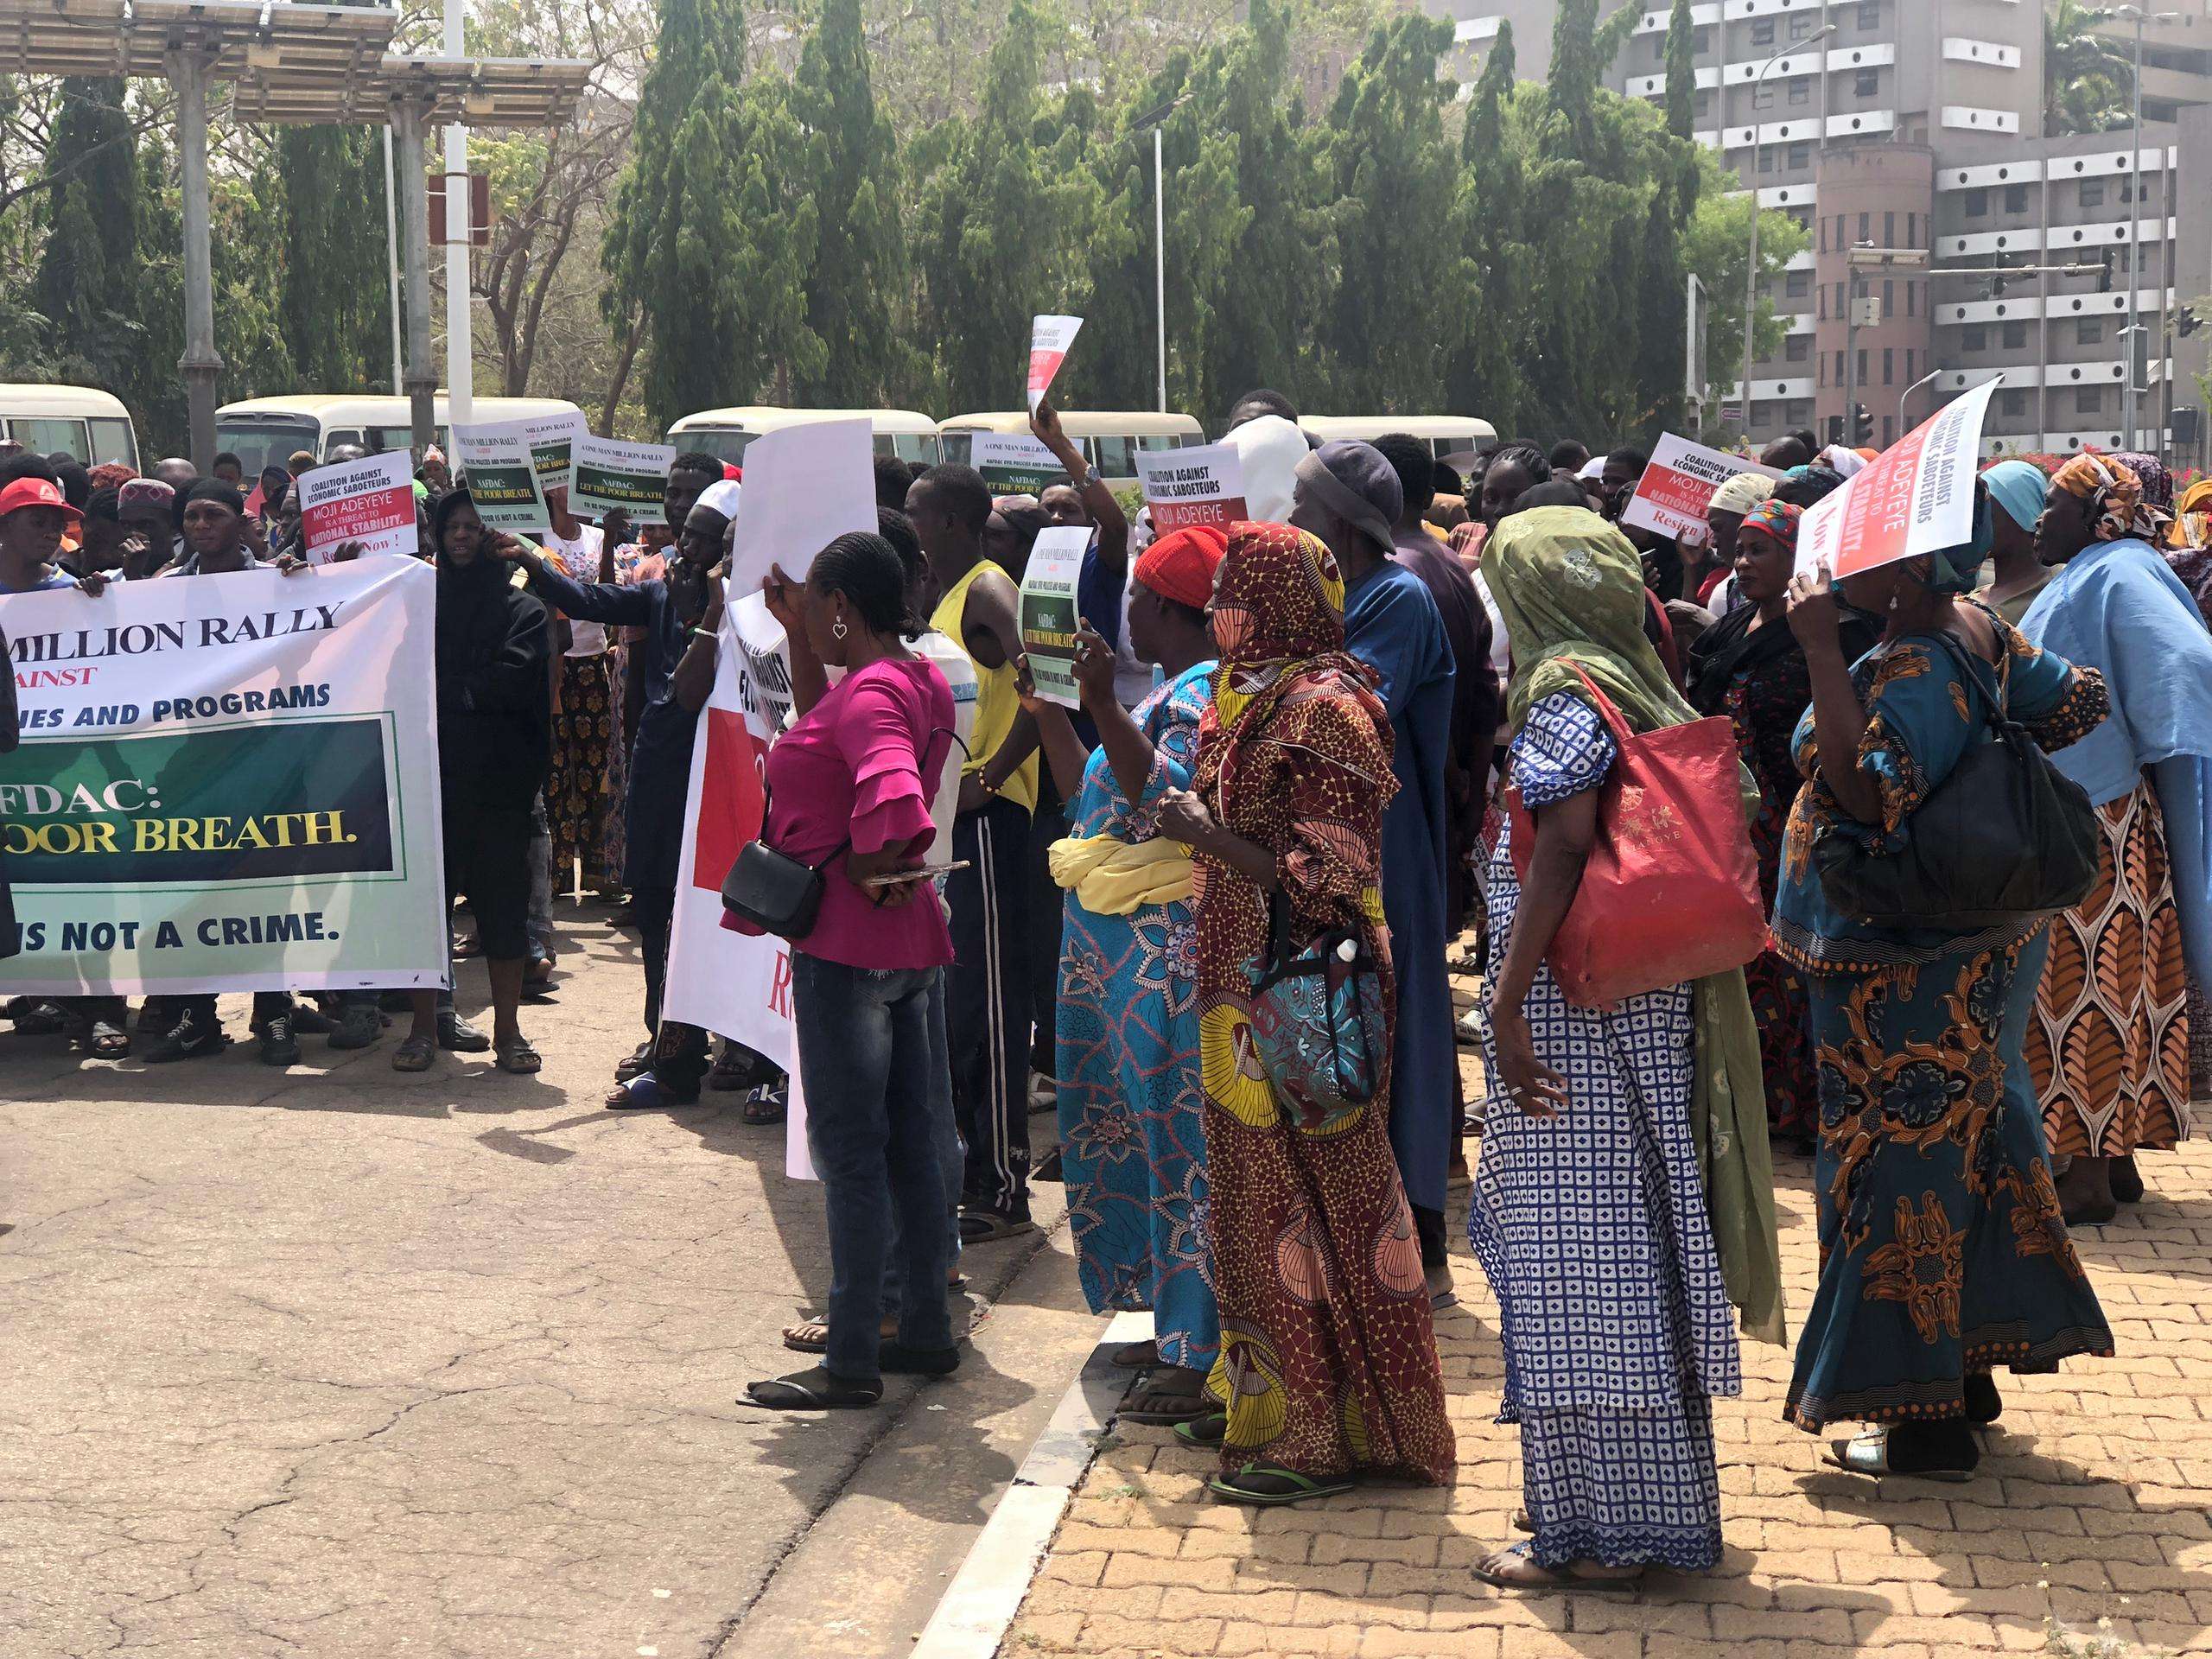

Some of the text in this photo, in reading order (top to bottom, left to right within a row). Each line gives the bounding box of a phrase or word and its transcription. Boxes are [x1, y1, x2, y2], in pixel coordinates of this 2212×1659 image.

[535, 454, 555, 462] DAC:
[551, 459, 571, 467] BREA
[612, 450, 639, 459] MILLION
[1684, 454, 1726, 474] COALITION
[1936, 407, 1968, 506] COALITION AGAINST
[1148, 466, 1209, 483] COALITION AGAINST
[1673, 459, 1715, 480] ECONOMIC
[308, 477, 391, 504] ECONOMIC SABOETEURS
[311, 469, 382, 493] COALITION AGAINST
[477, 479, 505, 488] NAFDAC:
[580, 482, 664, 499] LET THE POOR BREATH.
[602, 478, 635, 490] NAFDAC:
[997, 483, 1013, 492] THE
[1173, 480, 1220, 497] SABOETEURS
[1669, 474, 1702, 493] MOJI
[1917, 453, 1940, 524] SABOETEURS
[484, 489, 502, 499] POOR
[503, 488, 532, 498] BREATH.
[1649, 489, 1700, 516] NATIONAL
[1883, 460, 1915, 533] ADEYEYE
[313, 492, 392, 522] MOJI ADEYEYE
[338, 512, 366, 525] THREAT
[369, 510, 378, 518] TO
[1177, 503, 1224, 524] ADEYEYE
[311, 514, 404, 546] NATIONAL STABILITY.
[1653, 510, 1698, 537] Resign
[197, 601, 346, 647] RALLY
[16, 667, 98, 688] AINST
[18, 683, 331, 728] IES AND PROGRAMS
[0, 779, 162, 815] FDAC:
[3, 810, 358, 855] OOR BREATH.
[16, 912, 340, 951] IS NOT A CRIME.
